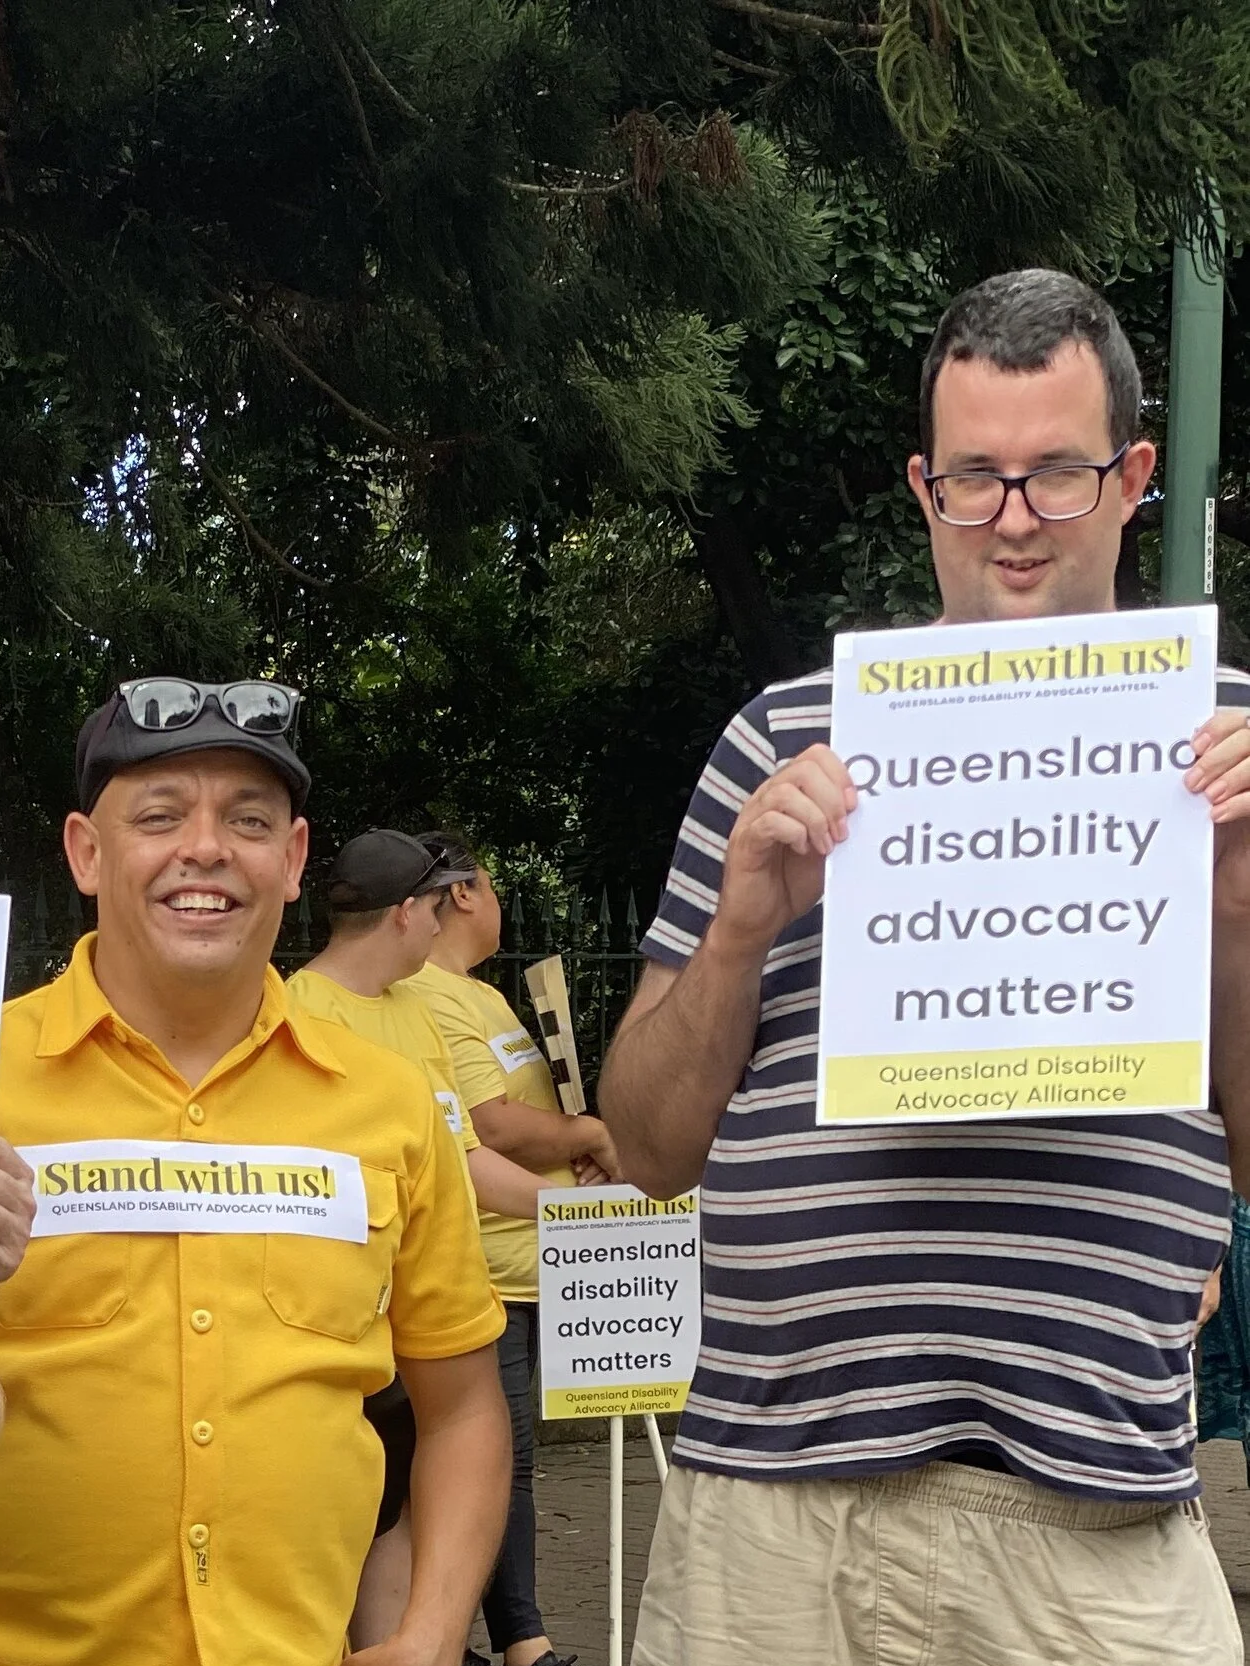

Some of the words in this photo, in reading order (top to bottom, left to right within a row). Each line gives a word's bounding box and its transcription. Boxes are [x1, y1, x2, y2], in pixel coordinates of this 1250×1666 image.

[864, 651, 991, 696] Stand
[1006, 642, 1105, 684] with
[1123, 634, 1185, 676] us!
[879, 811, 1160, 866] disability
[866, 897, 1169, 946] advocacy
[895, 976, 1136, 1022] matters
[879, 1058, 1028, 1084] Queensland
[1037, 1054, 1146, 1079] Disabilty
[895, 1084, 1017, 1112] Advocacy
[1027, 1083, 1127, 1105] Alliance
[44, 1157, 163, 1197] Stand
[174, 1160, 266, 1195] with
[278, 1165, 332, 1200] us!
[52, 1201, 136, 1215] QUEENSLAND
[138, 1201, 203, 1213] DISABILITY
[205, 1203, 273, 1214] ADVOCACY
[275, 1205, 328, 1218] MATTERS
[542, 1200, 604, 1223] Stand
[610, 1198, 657, 1218] with
[664, 1195, 695, 1215] us!
[542, 1238, 696, 1268] Queensland
[561, 1276, 679, 1301] disability
[557, 1315, 684, 1338] advocacy
[572, 1351, 672, 1374] matters
[566, 1390, 629, 1403] Queensland
[631, 1386, 679, 1400] Disability
[574, 1403, 627, 1415] Advocacy
[629, 1401, 671, 1411] Alliance
